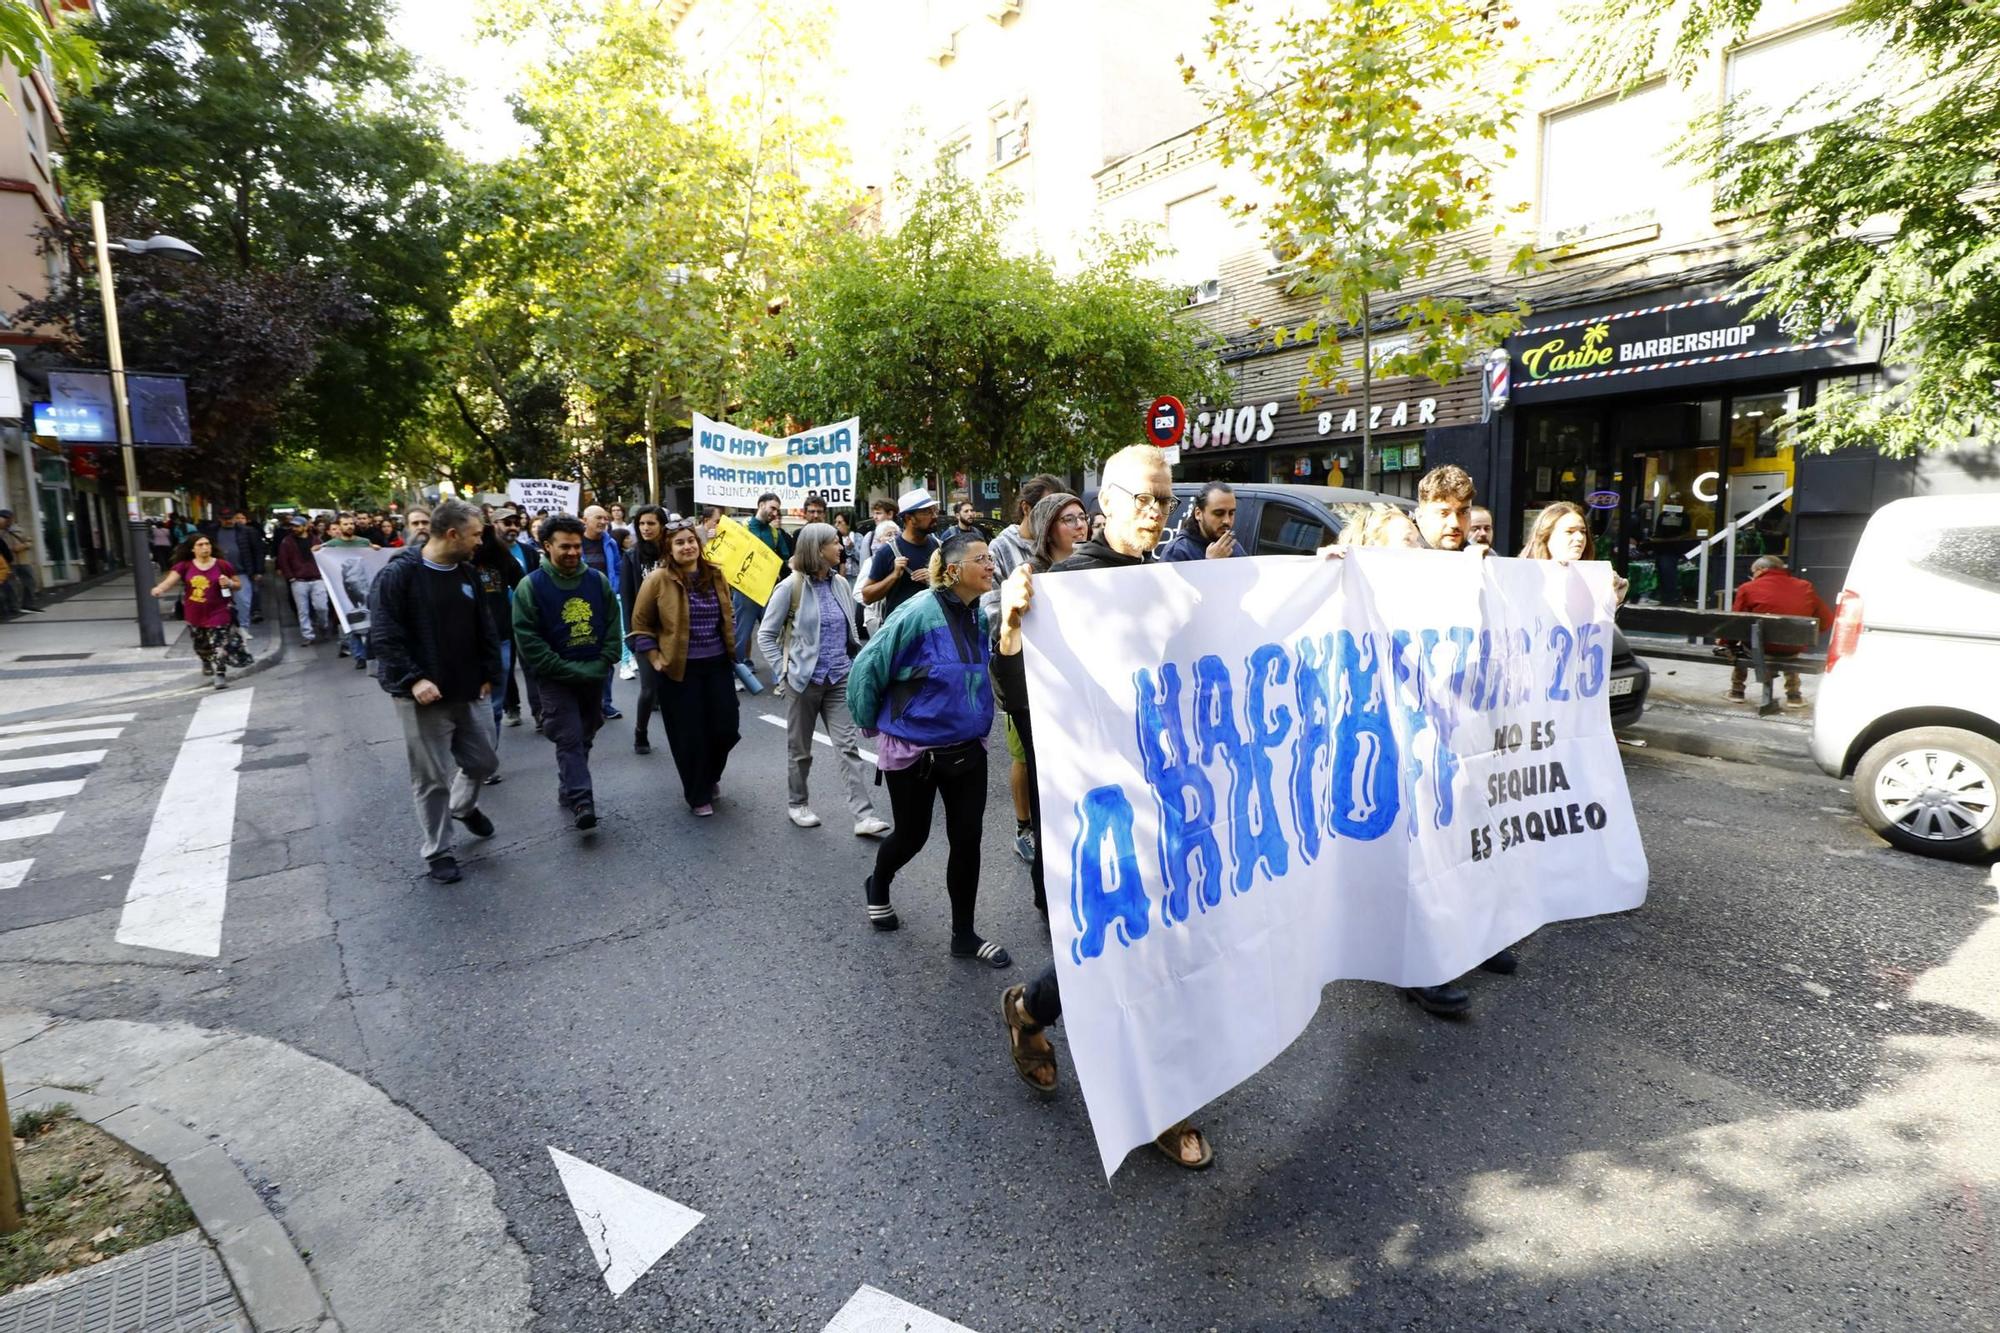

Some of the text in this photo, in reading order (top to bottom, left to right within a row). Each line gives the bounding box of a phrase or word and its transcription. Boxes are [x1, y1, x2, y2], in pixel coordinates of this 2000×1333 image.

[1521, 325, 1756, 380] Caribe BARBERSHOP
[700, 431, 725, 453] NO
[729, 437, 769, 457] HAY
[786, 428, 851, 456] AGUA
[1181, 398, 1437, 450] ICHOS BAZAR
[700, 464, 735, 485] PARA
[737, 470, 786, 486] TANTO
[1493, 720, 1556, 757] NO ES
[1487, 761, 1570, 808] SEQUIA
[1471, 802, 1607, 862] ES SAQUEO
